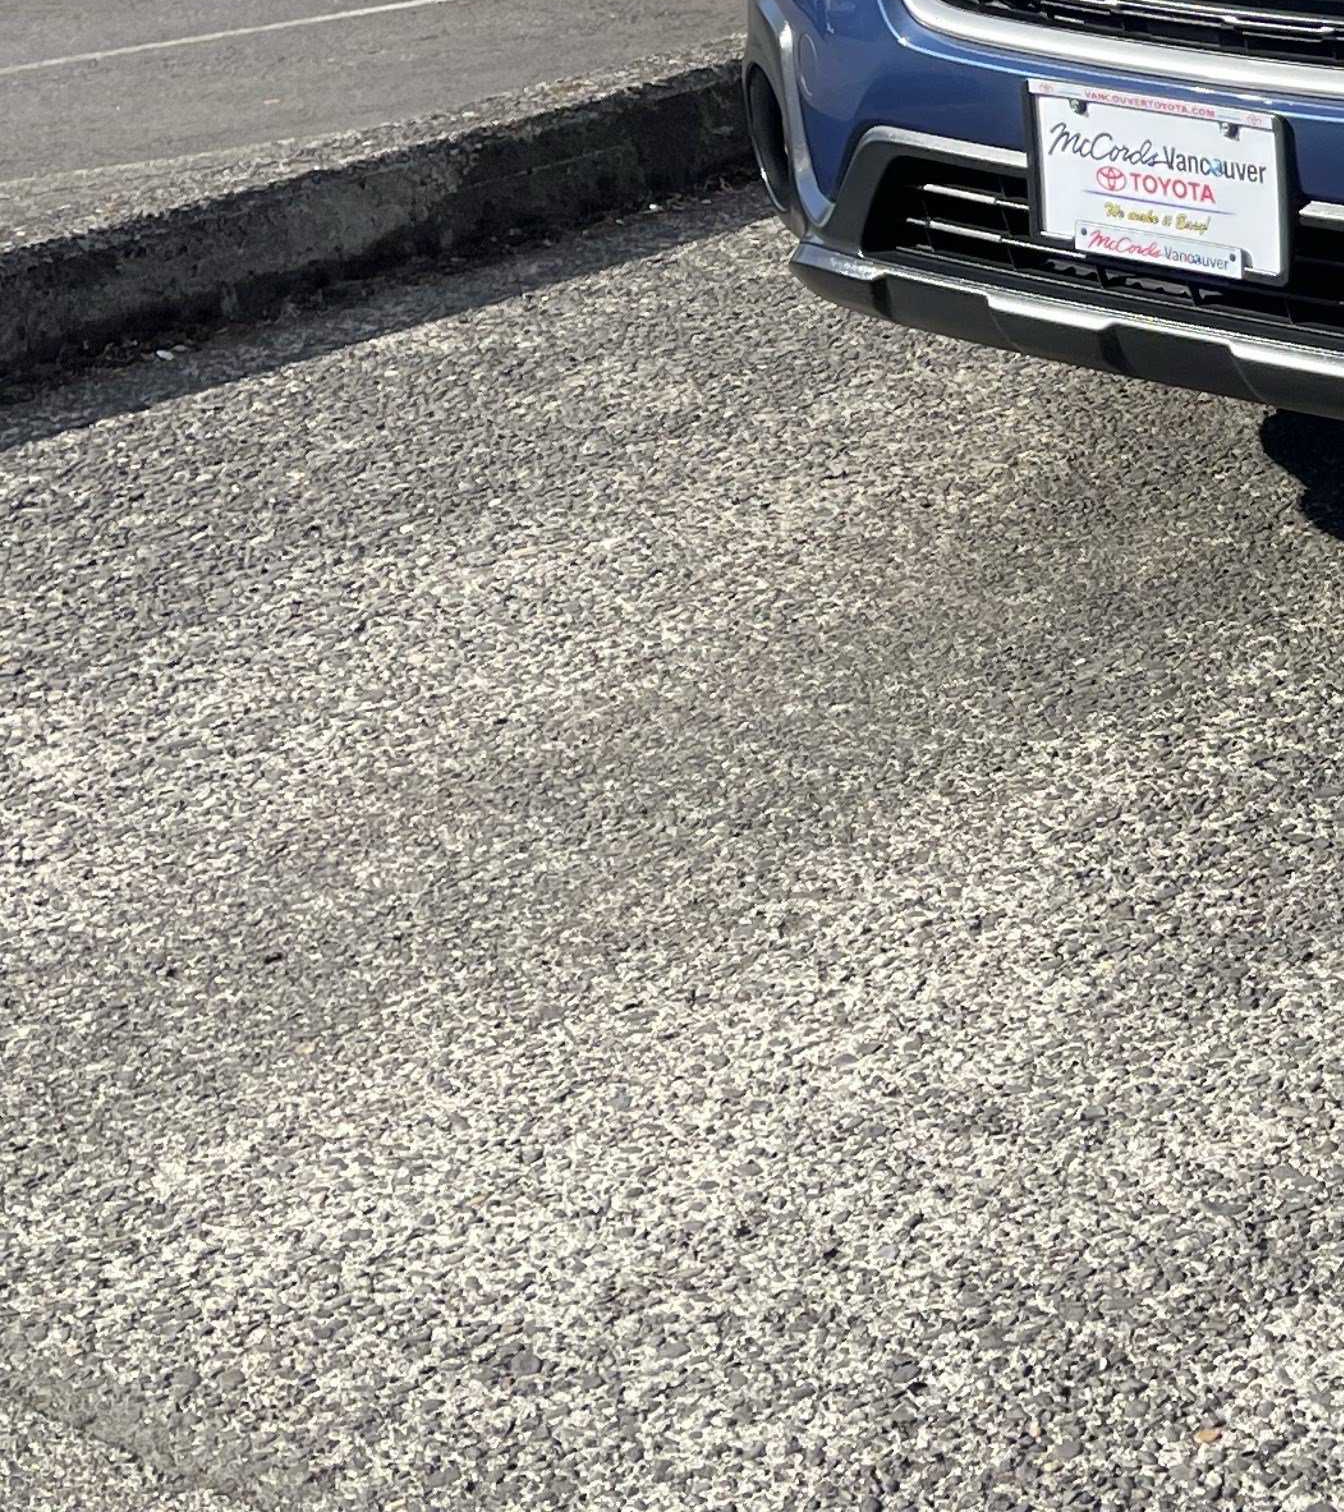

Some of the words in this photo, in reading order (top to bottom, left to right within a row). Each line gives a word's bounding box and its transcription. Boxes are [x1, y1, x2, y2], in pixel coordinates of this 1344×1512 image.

[1084, 90, 1216, 118] VANCOUVERTOYOTA.COM
[1130, 173, 1216, 204] TOYOTA
[1127, 209, 1159, 225] make
[1162, 215, 1173, 227] it
[1086, 228, 1164, 258] McCords
[1163, 245, 1229, 271] Vancouver
